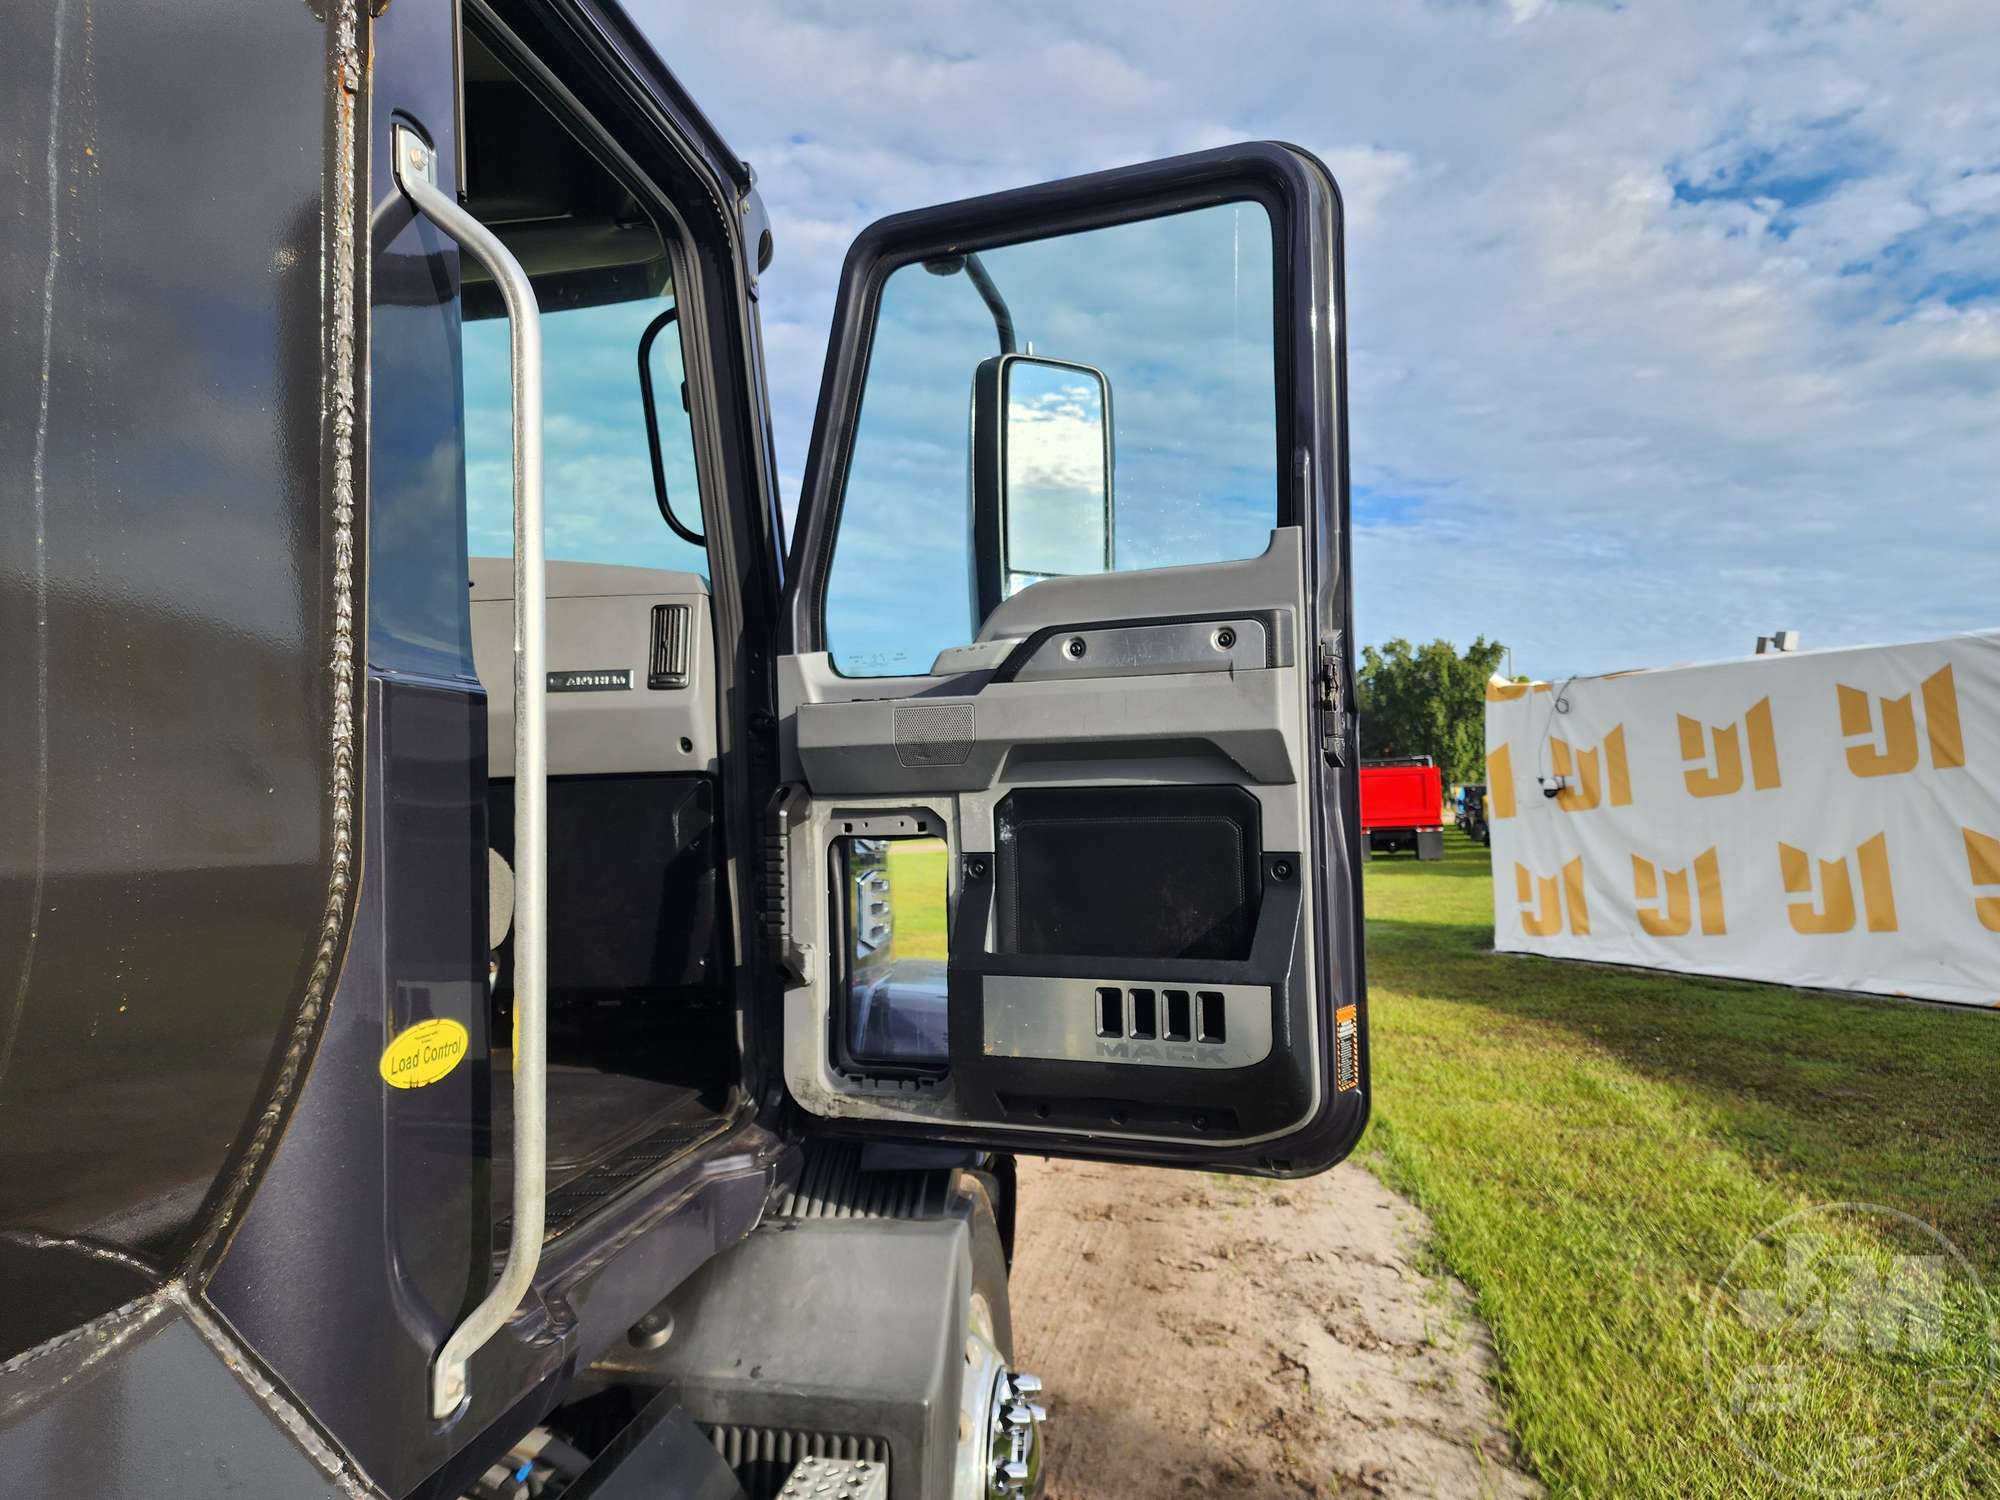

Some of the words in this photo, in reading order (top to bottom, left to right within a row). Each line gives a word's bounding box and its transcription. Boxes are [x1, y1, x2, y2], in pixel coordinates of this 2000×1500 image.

[391, 1048, 420, 1075] Load
[423, 1036, 462, 1064] Control
[1096, 1041, 1228, 1064] MACK
